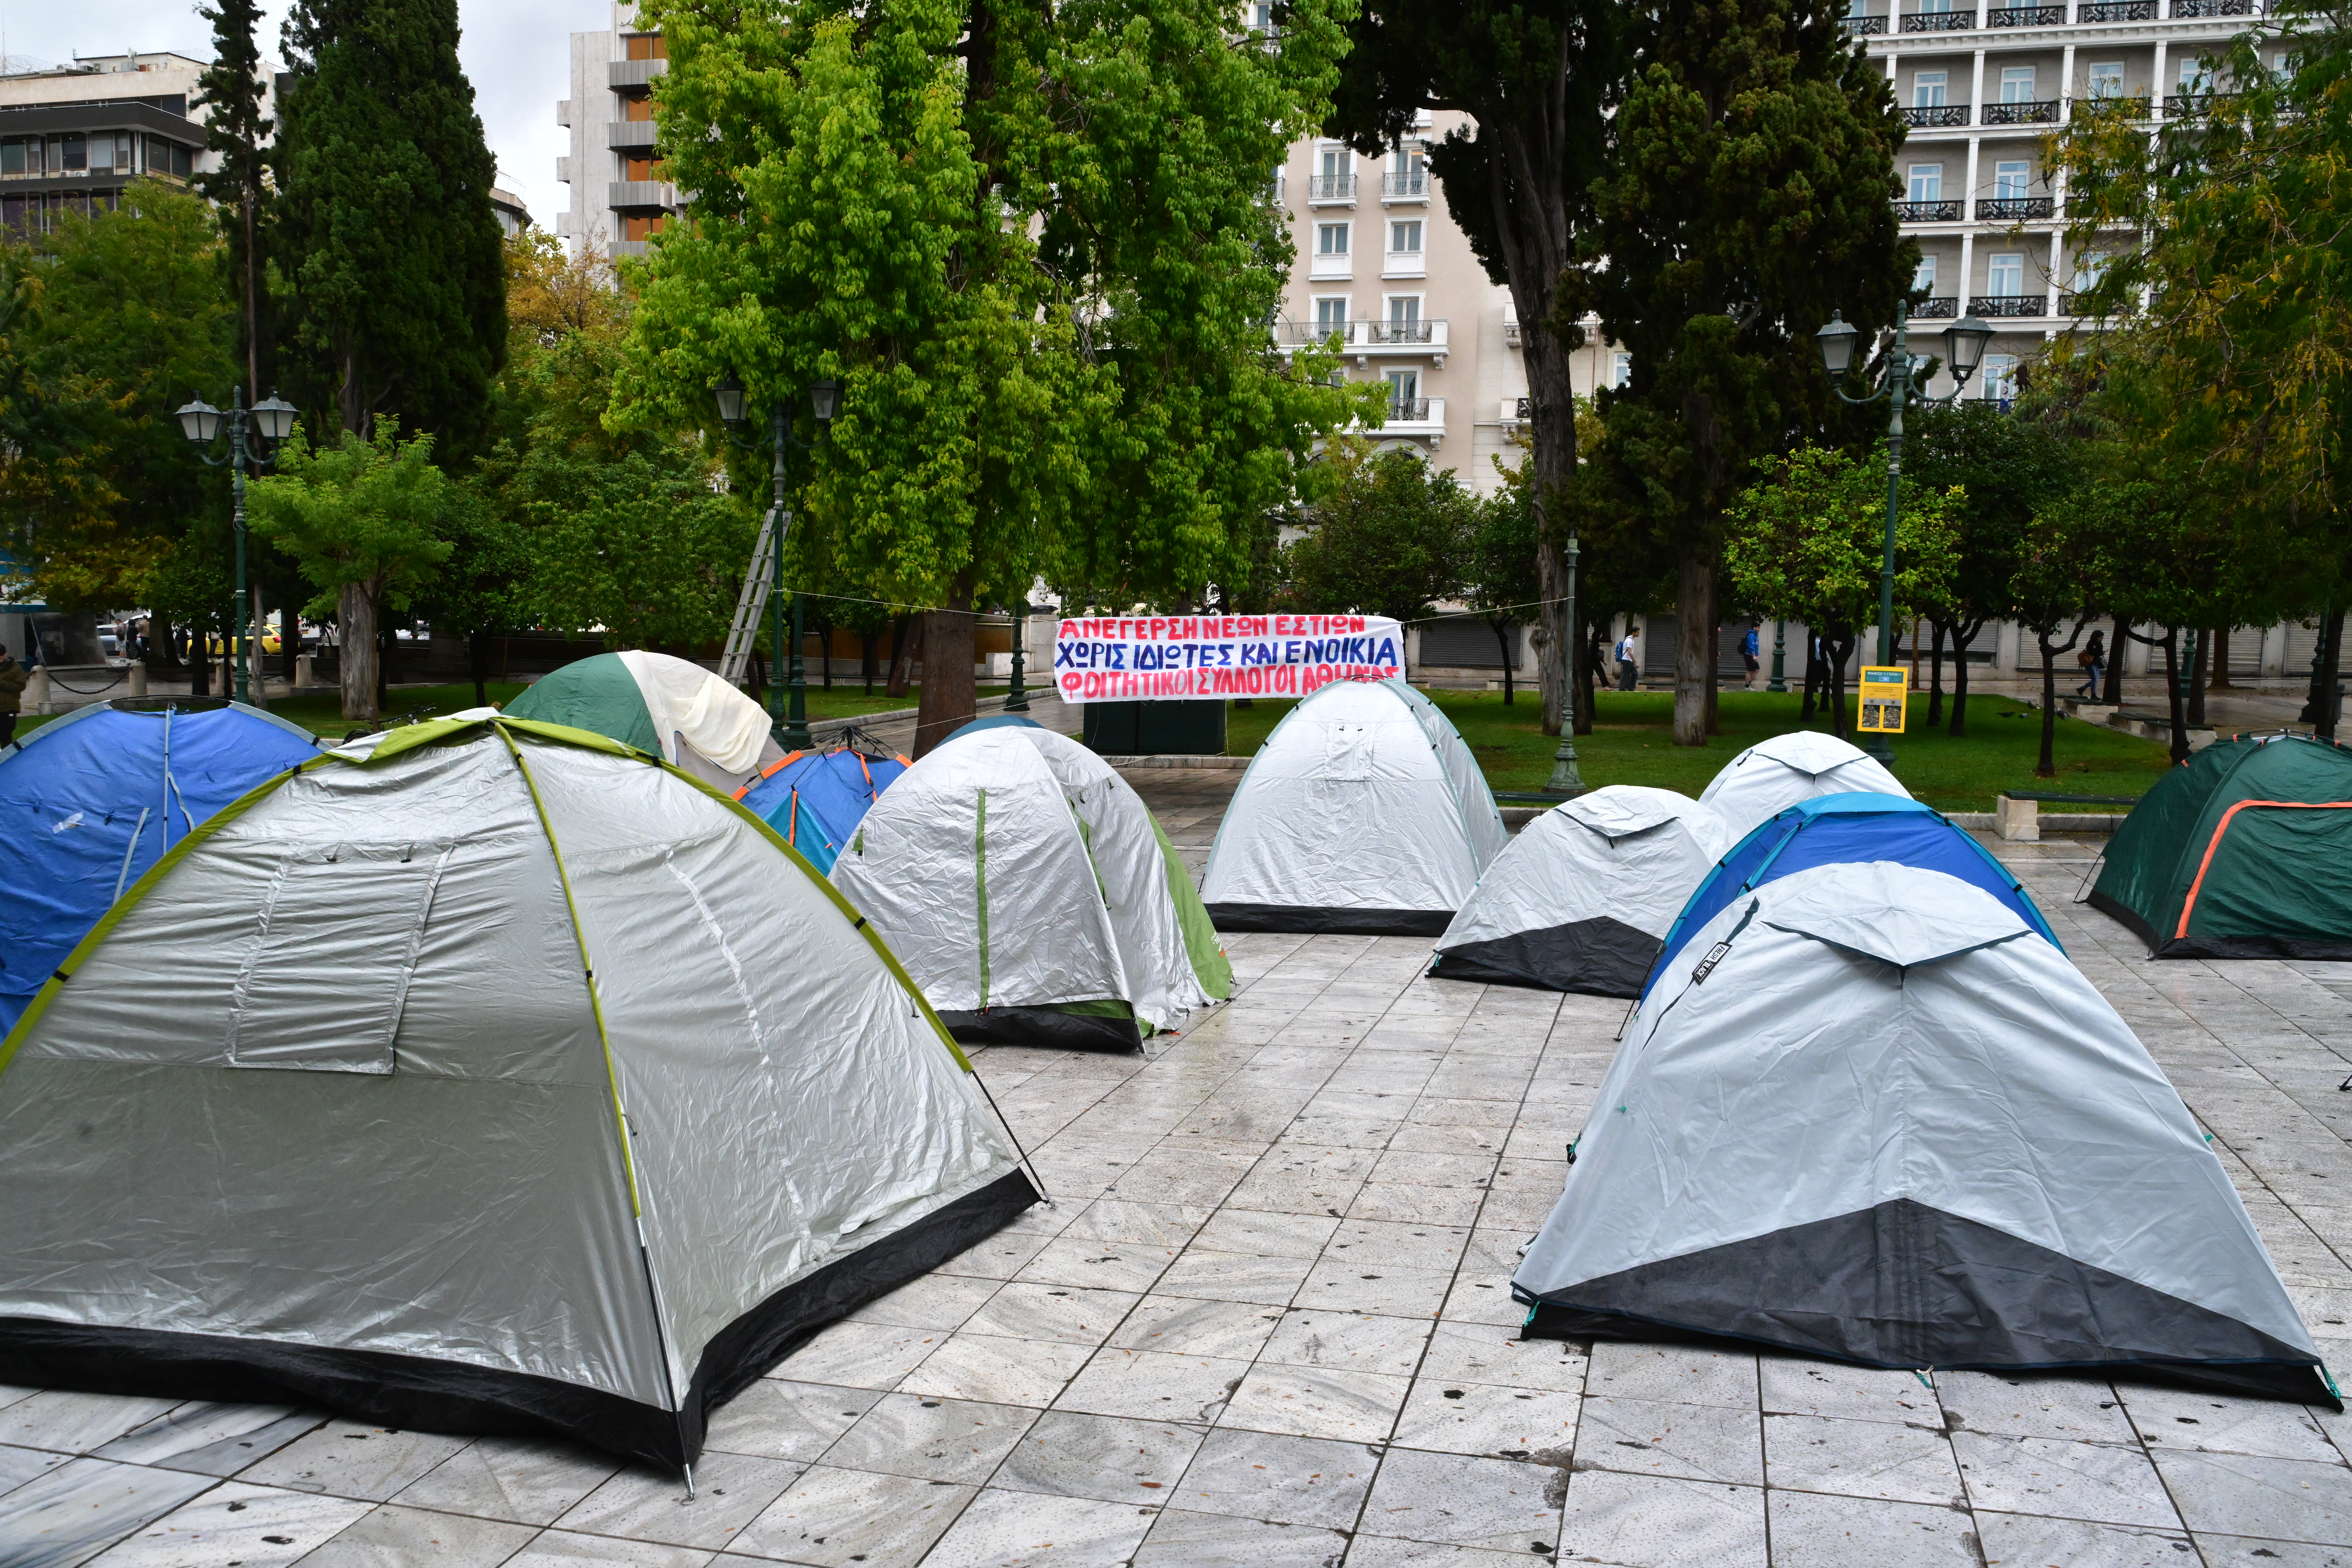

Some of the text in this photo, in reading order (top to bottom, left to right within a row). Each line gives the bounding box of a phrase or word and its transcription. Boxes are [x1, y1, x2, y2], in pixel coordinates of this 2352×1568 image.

[1059, 615, 1365, 640] ΑΝΕΓΕΡΣΗ ΝΕΩΝ ΕΣΤΙΩΝ
[1054, 637, 1397, 670] ΧΩΡΙΣ ΙΔΙΩΤΕΣ ΚΑΙ ΕΝΟΙΚΙΑ
[1061, 669, 1193, 700] ΦΟΙΤΗΤΙΚΟΙ
[1197, 664, 1297, 694] ΣΥΛΛΟΓΟΙ
[1696, 945, 1725, 977] FRESH BLACK
